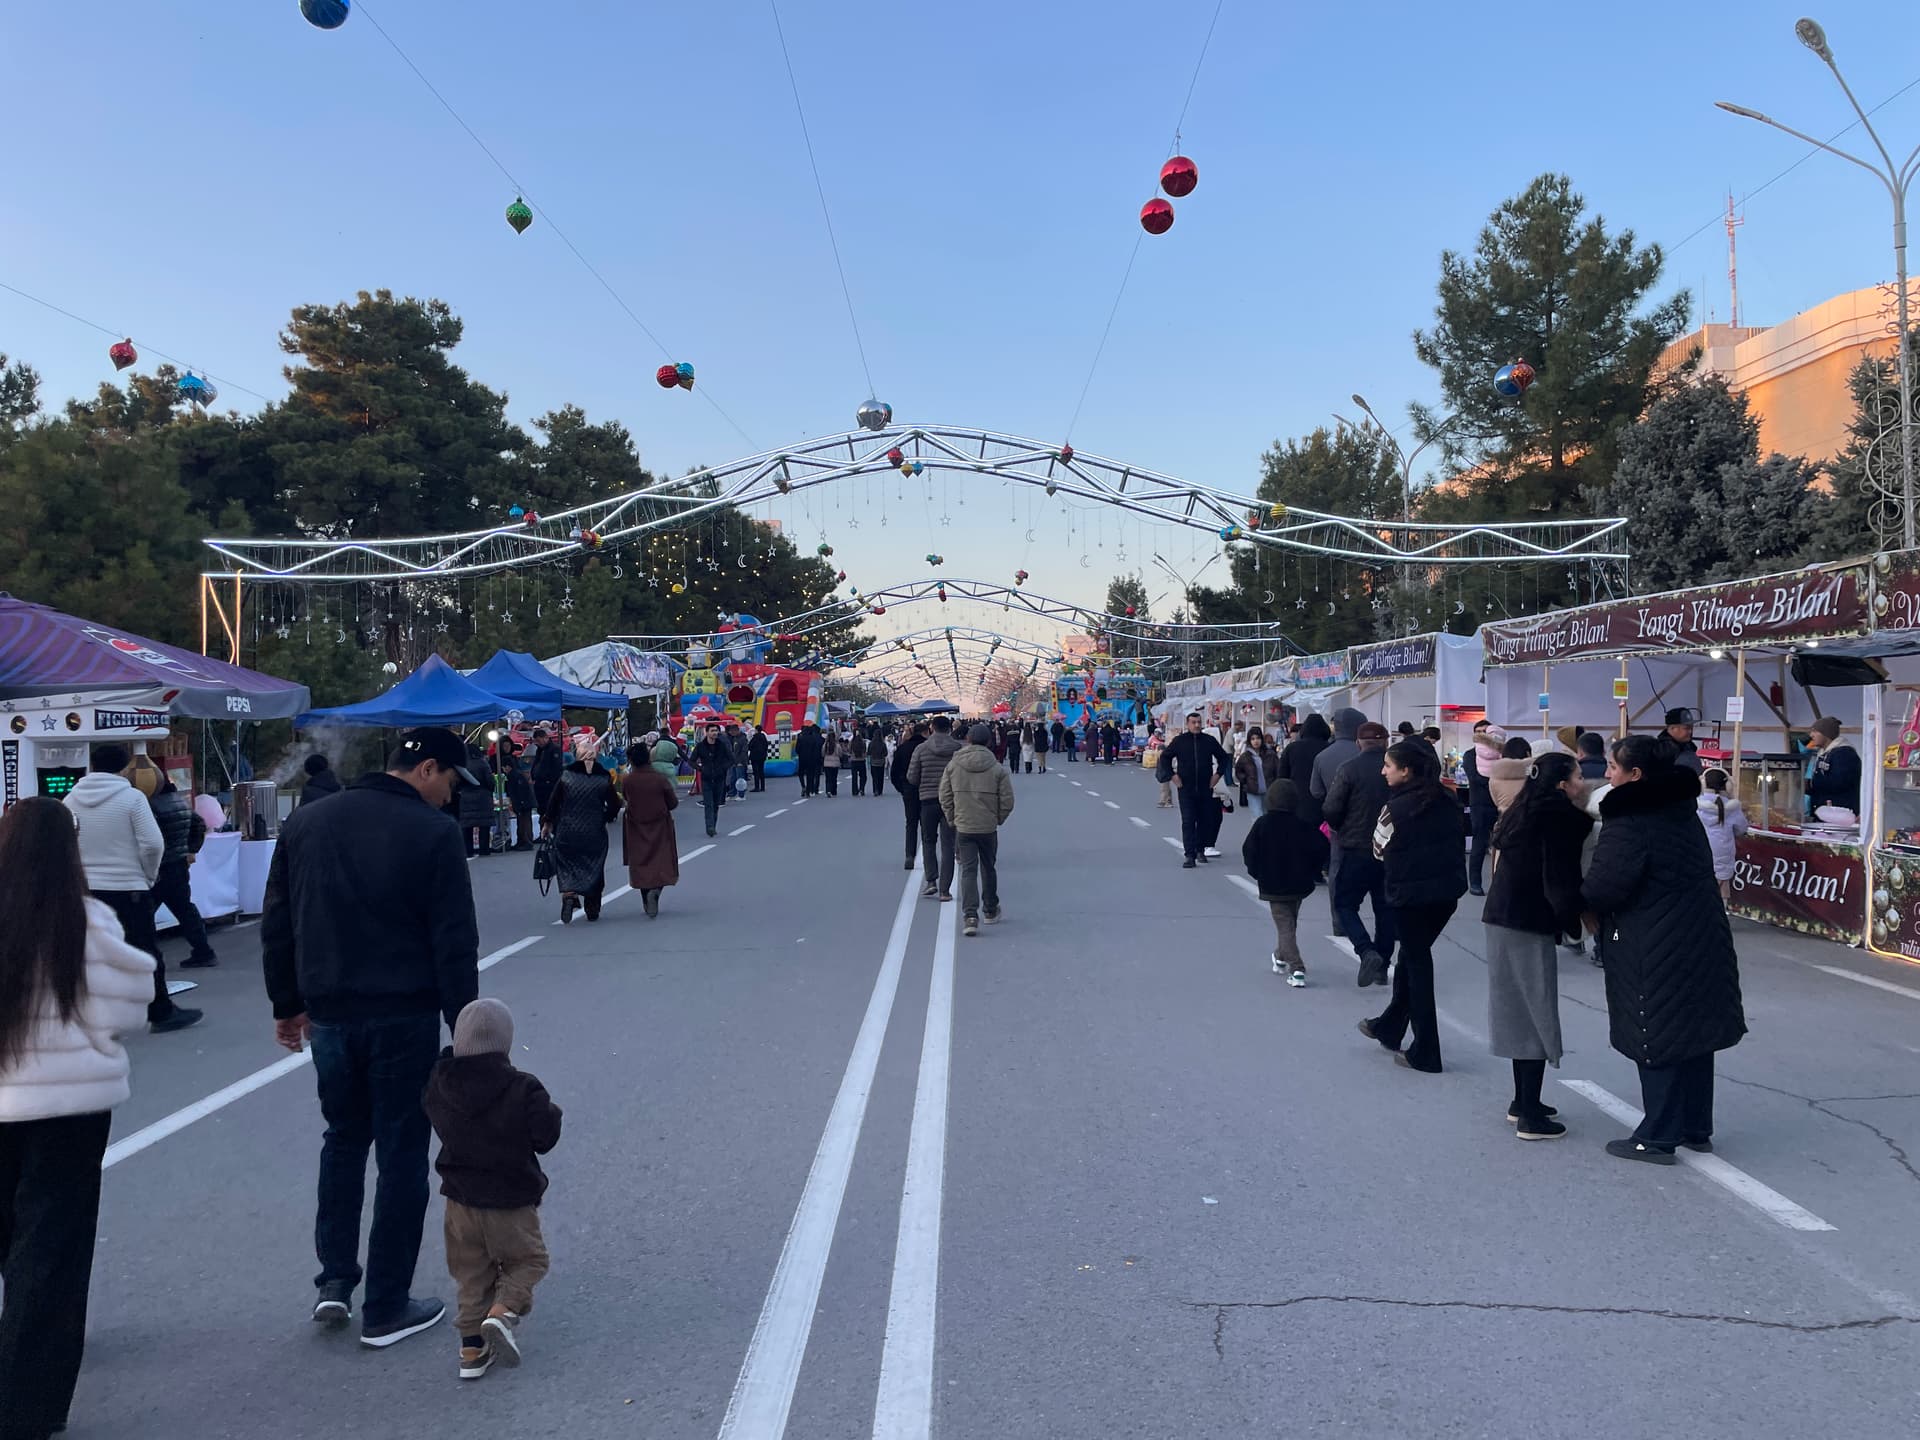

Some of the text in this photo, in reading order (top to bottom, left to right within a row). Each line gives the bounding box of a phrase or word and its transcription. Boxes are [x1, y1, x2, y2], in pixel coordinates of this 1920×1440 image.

[1637, 604, 1684, 643] Yangi
[1690, 593, 1764, 637] Yilingiz
[1767, 575, 1844, 624] Bilan!
[1569, 614, 1611, 647] Bilan!
[1403, 643, 1430, 666] Bilan!
[97, 712, 159, 728] FIGHTING
[4, 745, 17, 806] FIGHTIN
[1770, 857, 1851, 904] Bilan!
